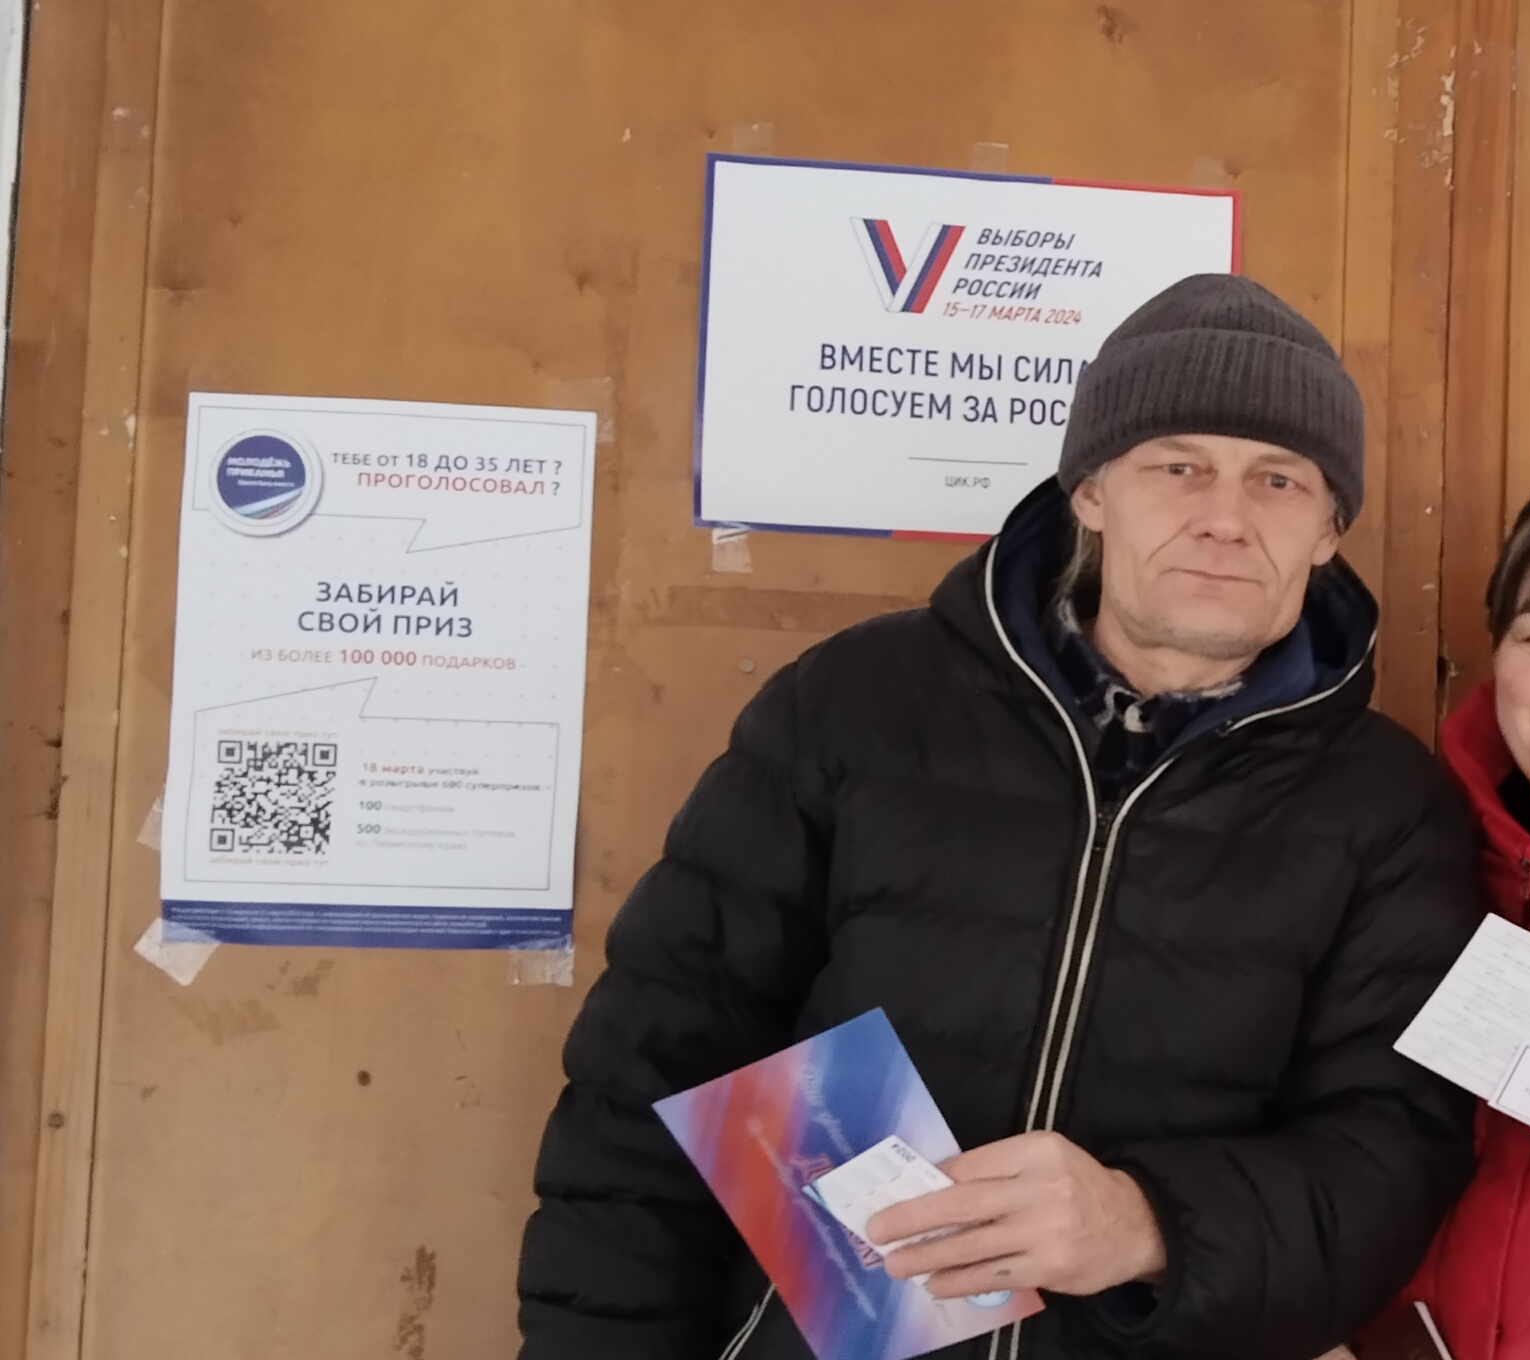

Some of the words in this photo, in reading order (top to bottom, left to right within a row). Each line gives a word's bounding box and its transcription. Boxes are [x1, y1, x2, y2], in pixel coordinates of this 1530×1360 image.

[977, 227, 1075, 251] ВЫБОРЫ
[964, 253, 1104, 279] ПРЕЗИДЕНТА
[952, 279, 1043, 300] РОССИИ
[990, 305, 1041, 323] МАРТА
[1045, 309, 1083, 326] 2024
[820, 343, 939, 377] ВМЕСТЕ
[950, 352, 1003, 381] МЫ
[789, 385, 952, 421] ГОЛОСУЕМ
[962, 396, 999, 423] ЗА
[1010, 397, 1067, 426] РОС
[331, 452, 371, 467] ТЕБЕ
[377, 455, 400, 468] ОТ
[406, 453, 428, 469] 18
[434, 455, 469, 473] ДО
[475, 456, 499, 472] 35
[504, 458, 549, 475] ЛЕТ
[357, 471, 546, 496] ПРОГОЛОСОВАЛ
[944, 475, 992, 490] ЦИК.РФ
[315, 581, 460, 608] ЗАБИРАЙ
[297, 608, 382, 635] СВОЙ
[392, 615, 474, 638] ПРИЗ
[250, 648, 273, 662] ИЗ
[278, 649, 334, 664] БОЛЕЕ
[339, 649, 378, 665] 100
[380, 650, 418, 666] 000
[421, 654, 517, 671] ПОДАРКОВ
